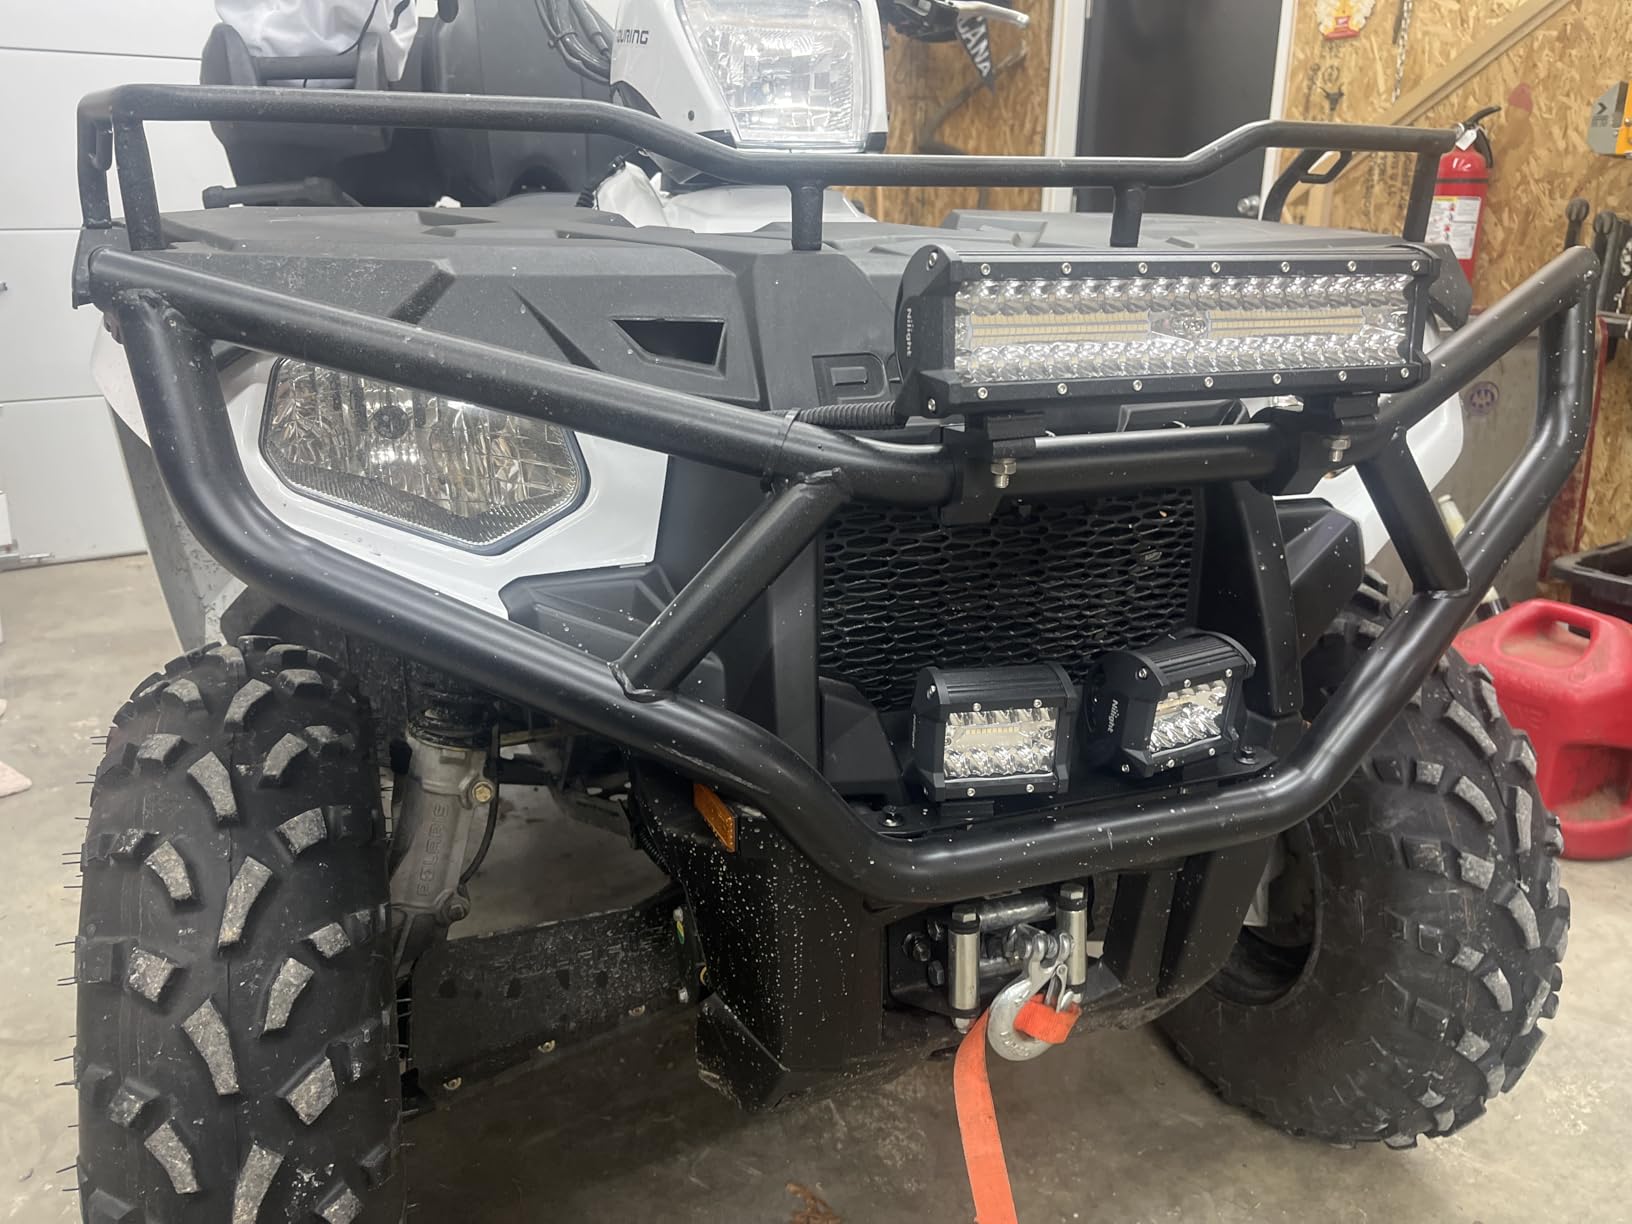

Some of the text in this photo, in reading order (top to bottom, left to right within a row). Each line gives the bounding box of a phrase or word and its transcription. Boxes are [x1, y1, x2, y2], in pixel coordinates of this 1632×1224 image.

[905, 308, 914, 357] Nilight
[1108, 699, 1119, 734] Nilight
[417, 801, 448, 897] POLARIS
